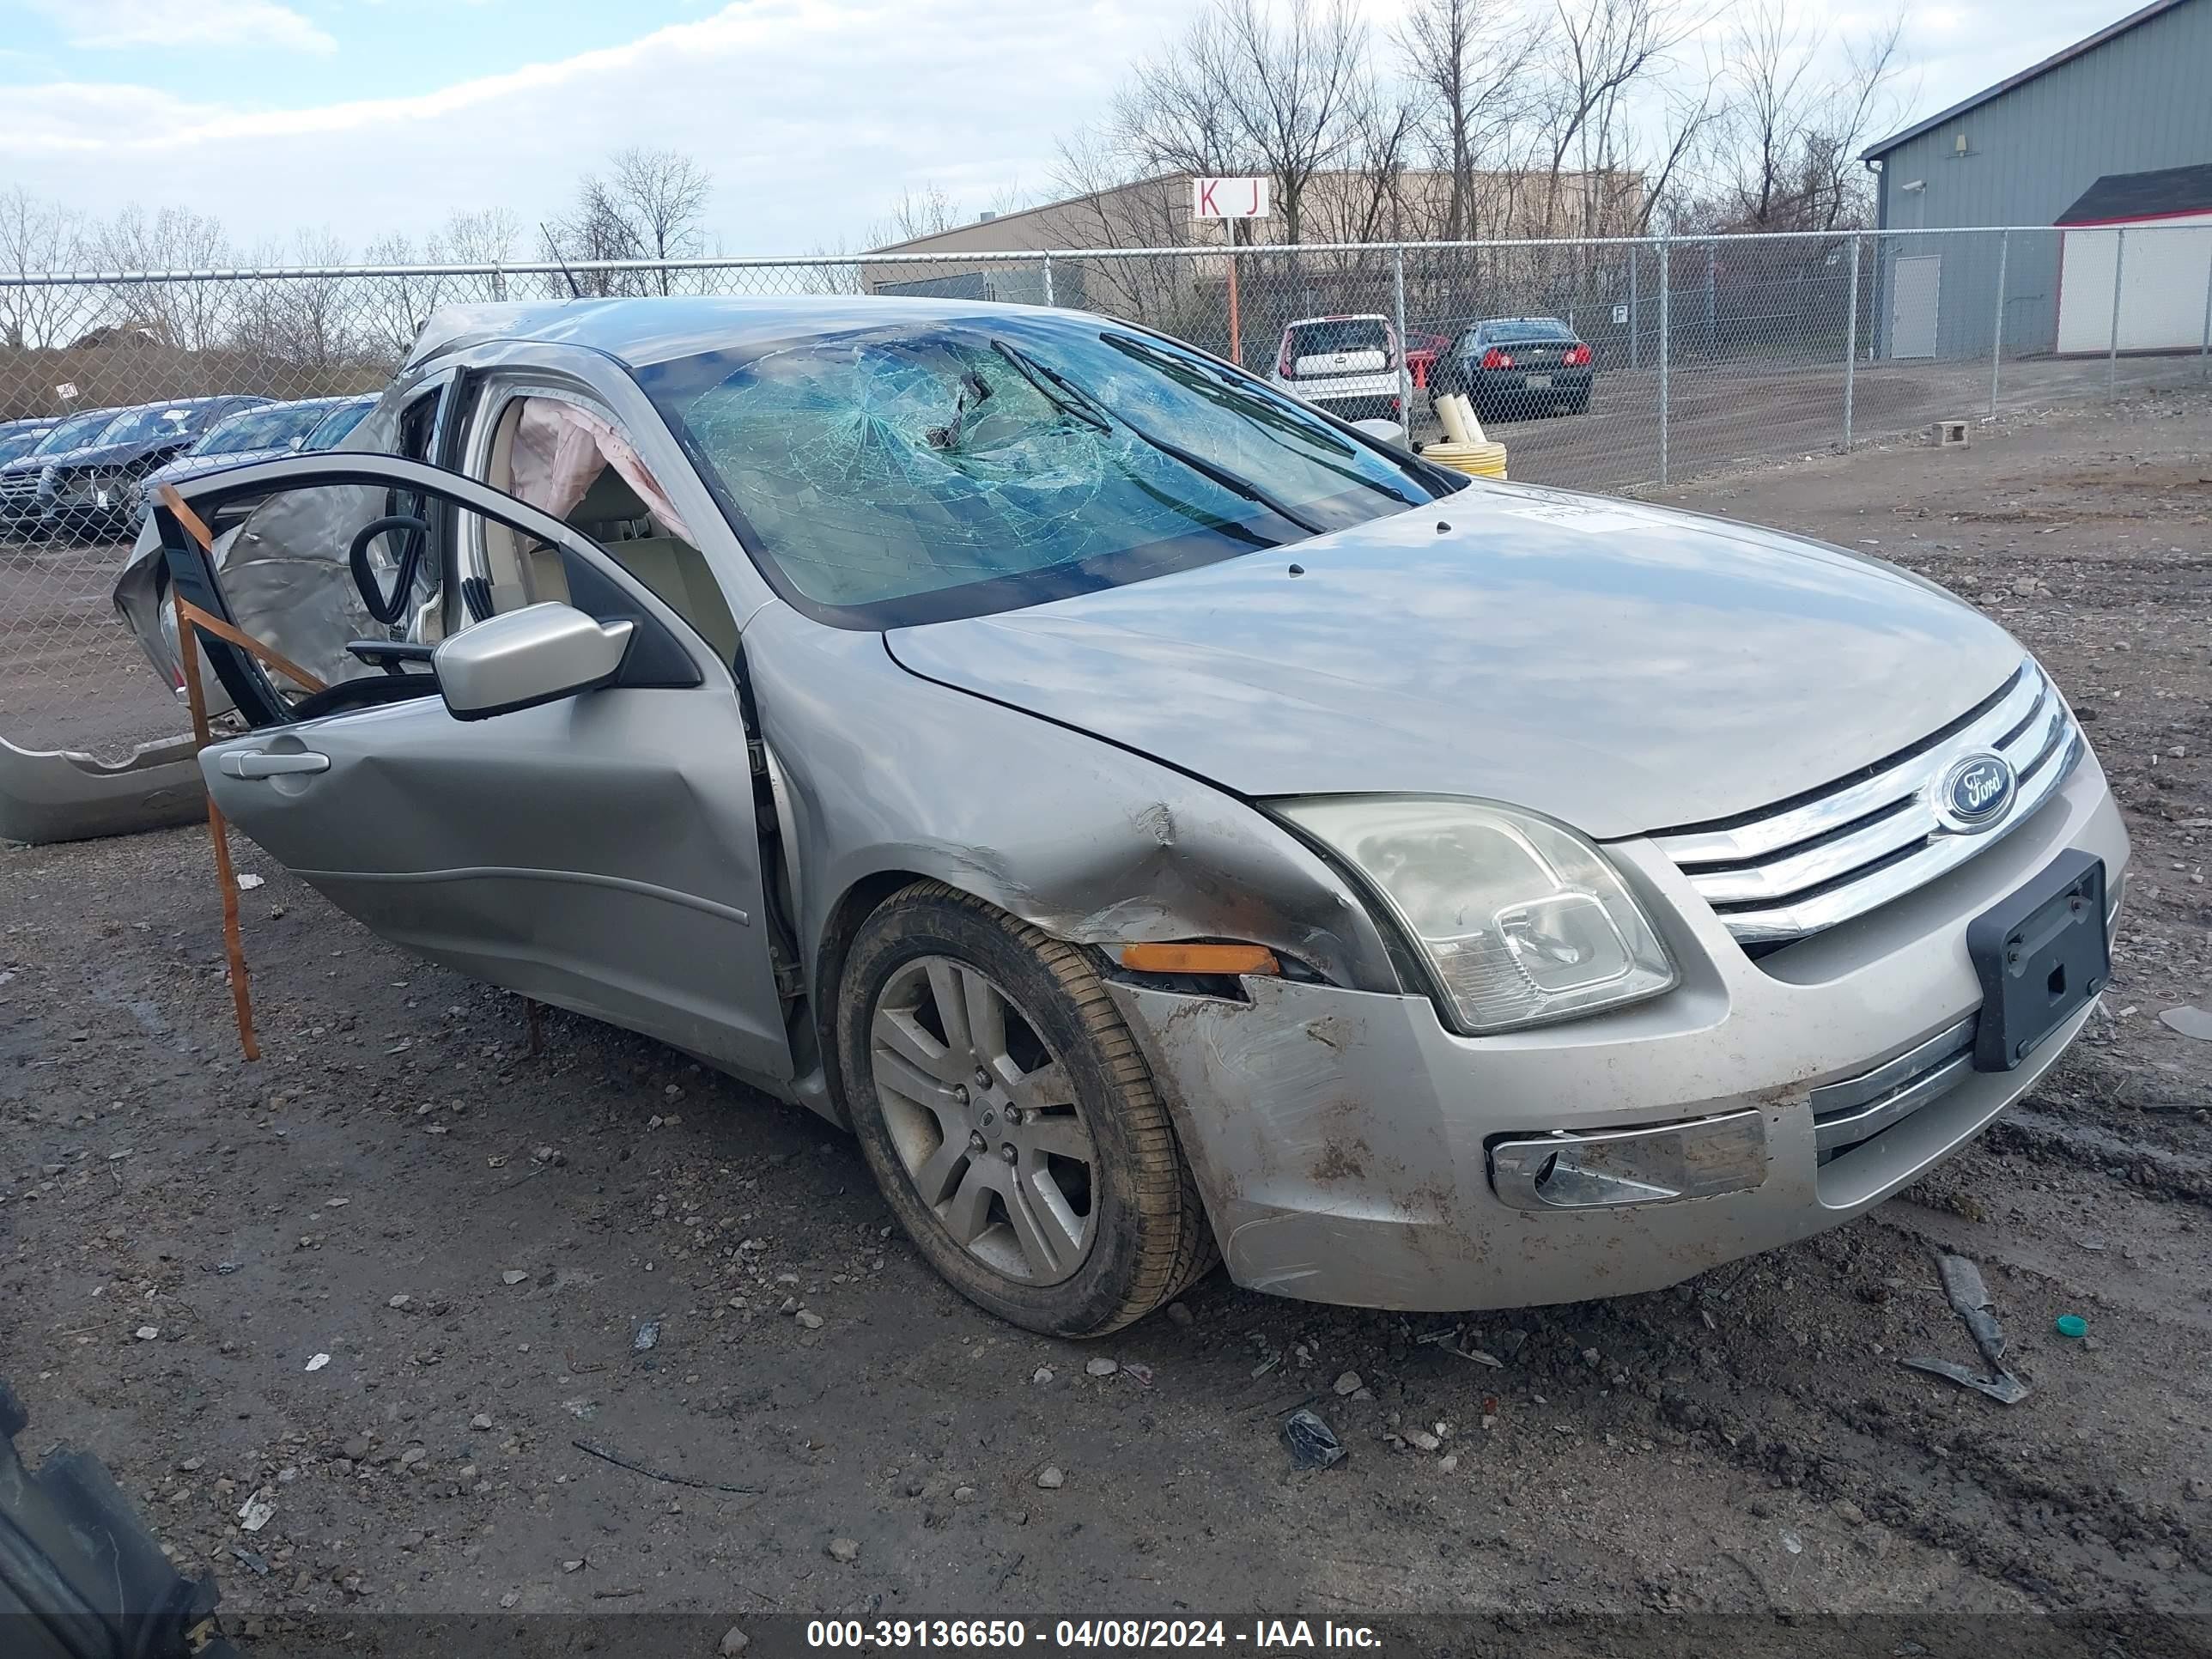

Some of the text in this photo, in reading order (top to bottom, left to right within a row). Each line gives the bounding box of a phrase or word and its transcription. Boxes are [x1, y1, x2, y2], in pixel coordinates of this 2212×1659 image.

[1200, 179, 1258, 216] K J
[1964, 766, 2003, 807] Ford
